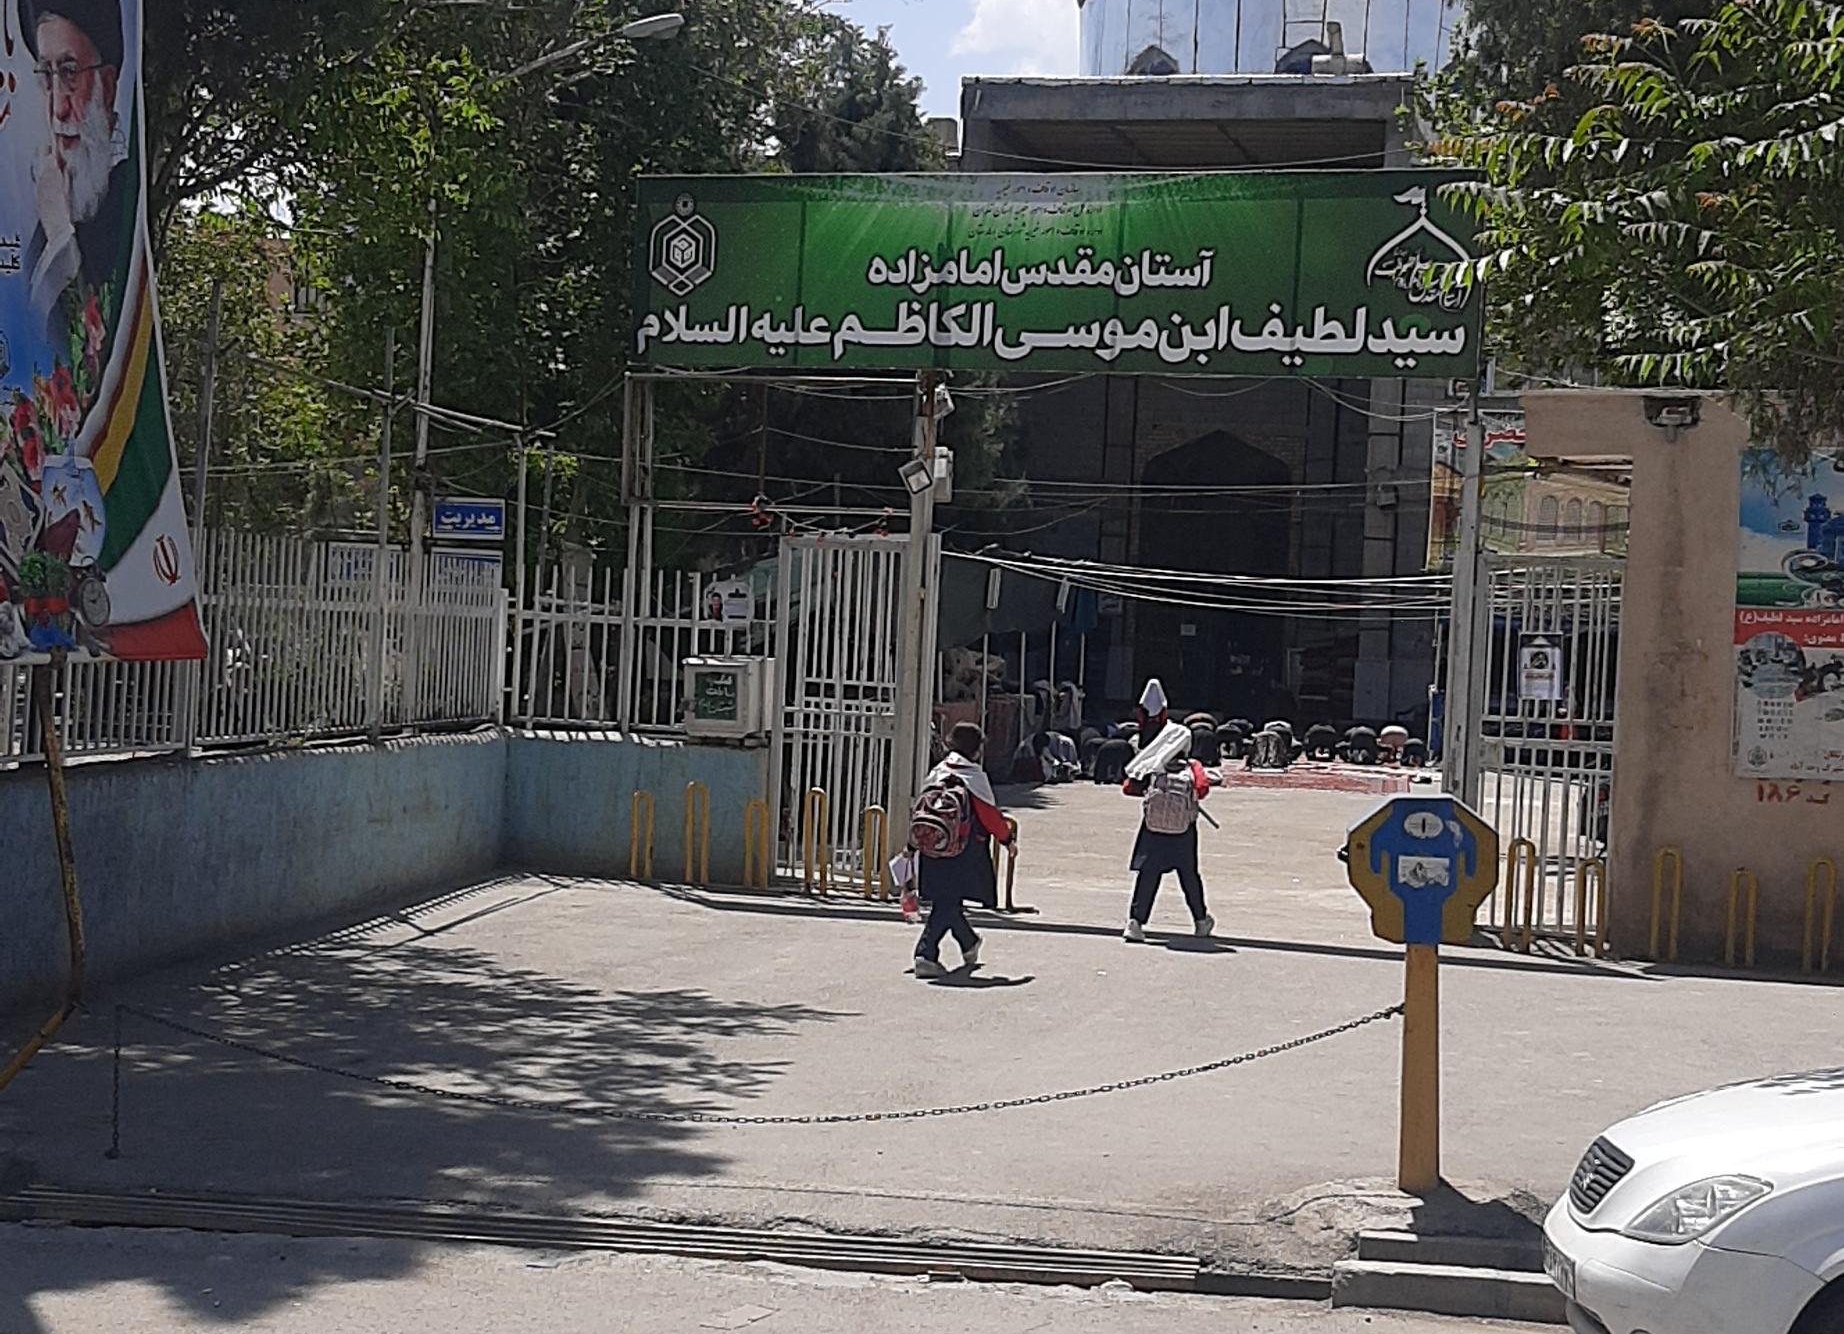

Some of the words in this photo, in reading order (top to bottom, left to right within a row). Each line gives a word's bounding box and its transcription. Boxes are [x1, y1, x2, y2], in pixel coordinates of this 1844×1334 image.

[867, 248, 1001, 296] امامزاده
[1001, 247, 1116, 296] مقدس
[1116, 248, 1216, 297] آستان
[636, 303, 750, 355] السلام
[750, 305, 834, 356] علیه
[832, 301, 994, 361] الکاظم
[994, 318, 1160, 362] موسی
[1158, 304, 1230, 366] ابن
[1230, 302, 1367, 367] لطیف
[1366, 317, 1467, 369] سید
[440, 511, 498, 530] مدیریت
